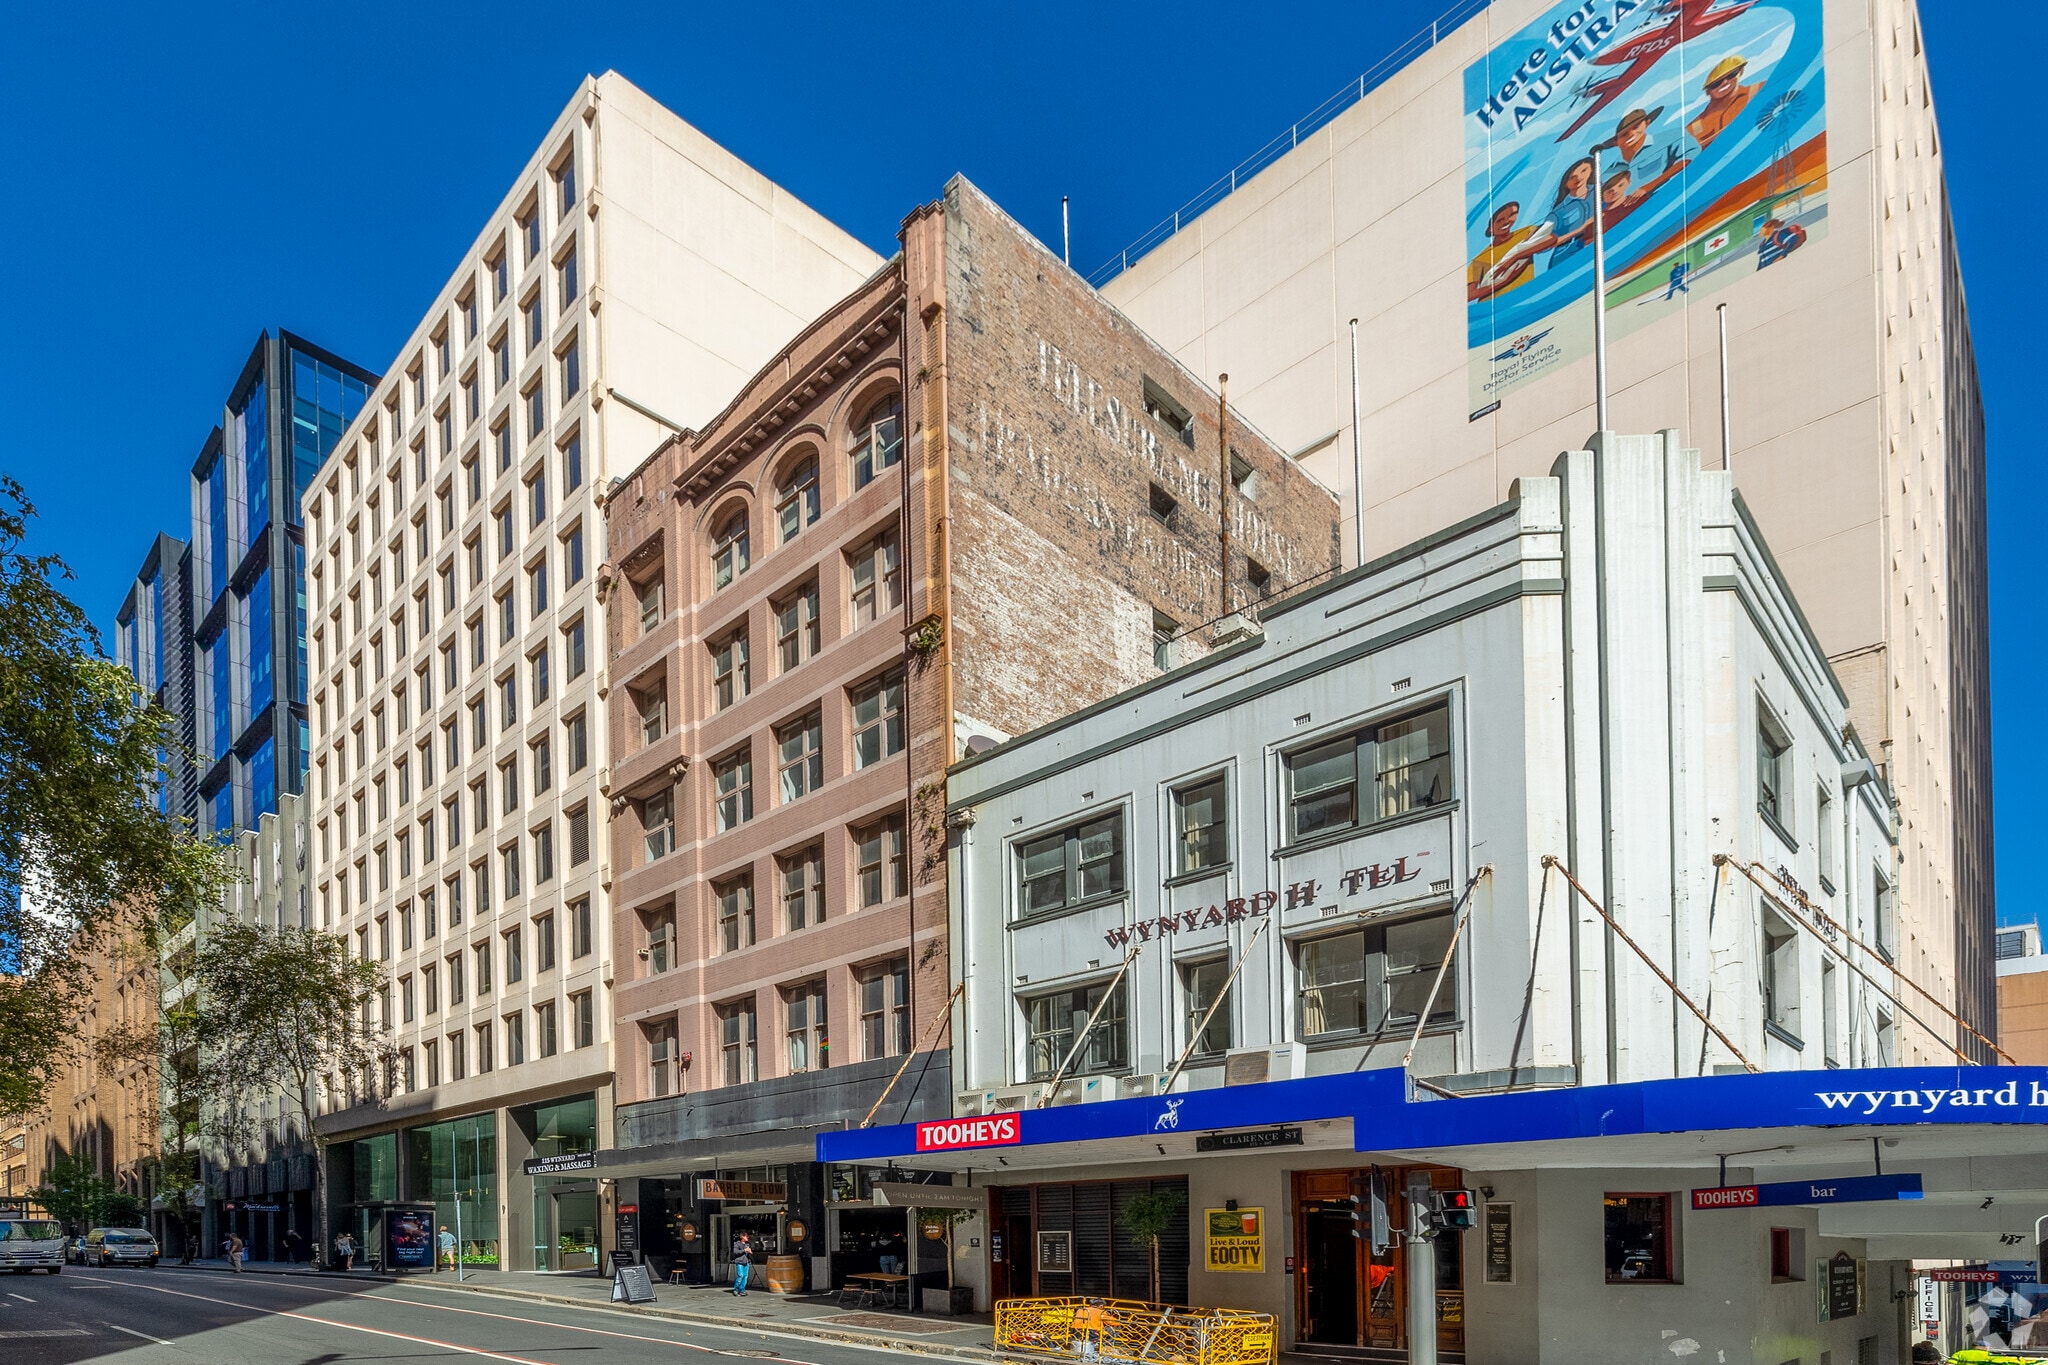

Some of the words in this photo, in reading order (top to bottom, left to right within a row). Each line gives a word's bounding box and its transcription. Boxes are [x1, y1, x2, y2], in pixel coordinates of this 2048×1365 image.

[1624, 35, 1675, 61] RFDS
[1476, 48, 1548, 129] Here
[1550, 0, 1596, 46] for
[1483, 369, 1521, 391] Doctor
[1521, 348, 1562, 372] Service
[1490, 360, 1520, 380] Royal
[1521, 344, 1555, 363] Flying
[1104, 890, 1278, 949] WYNYARD
[1284, 855, 1421, 912] HTEL
[1814, 1081, 2018, 1115] wynyard
[922, 1118, 1015, 1146] TOOHEYS
[1223, 1132, 1279, 1144] CLARENCE
[1285, 1130, 1299, 1139] ST
[527, 1164, 554, 1174] WAXING
[560, 1160, 592, 1170] MASSAGE
[550, 1154, 575, 1163] WYNYARD
[705, 1182, 743, 1194] BARREL
[752, 1183, 784, 1195] BELOW
[887, 1191, 908, 1199] OPEN
[1697, 1189, 1755, 1205] TOOHEYS
[1810, 1185, 1837, 1198] bar
[1210, 1238, 1227, 1246] Live
[1228, 1238, 1235, 1246] &
[1237, 1237, 1260, 1246] Loud
[1935, 1271, 1996, 1280] TOOHEYS
